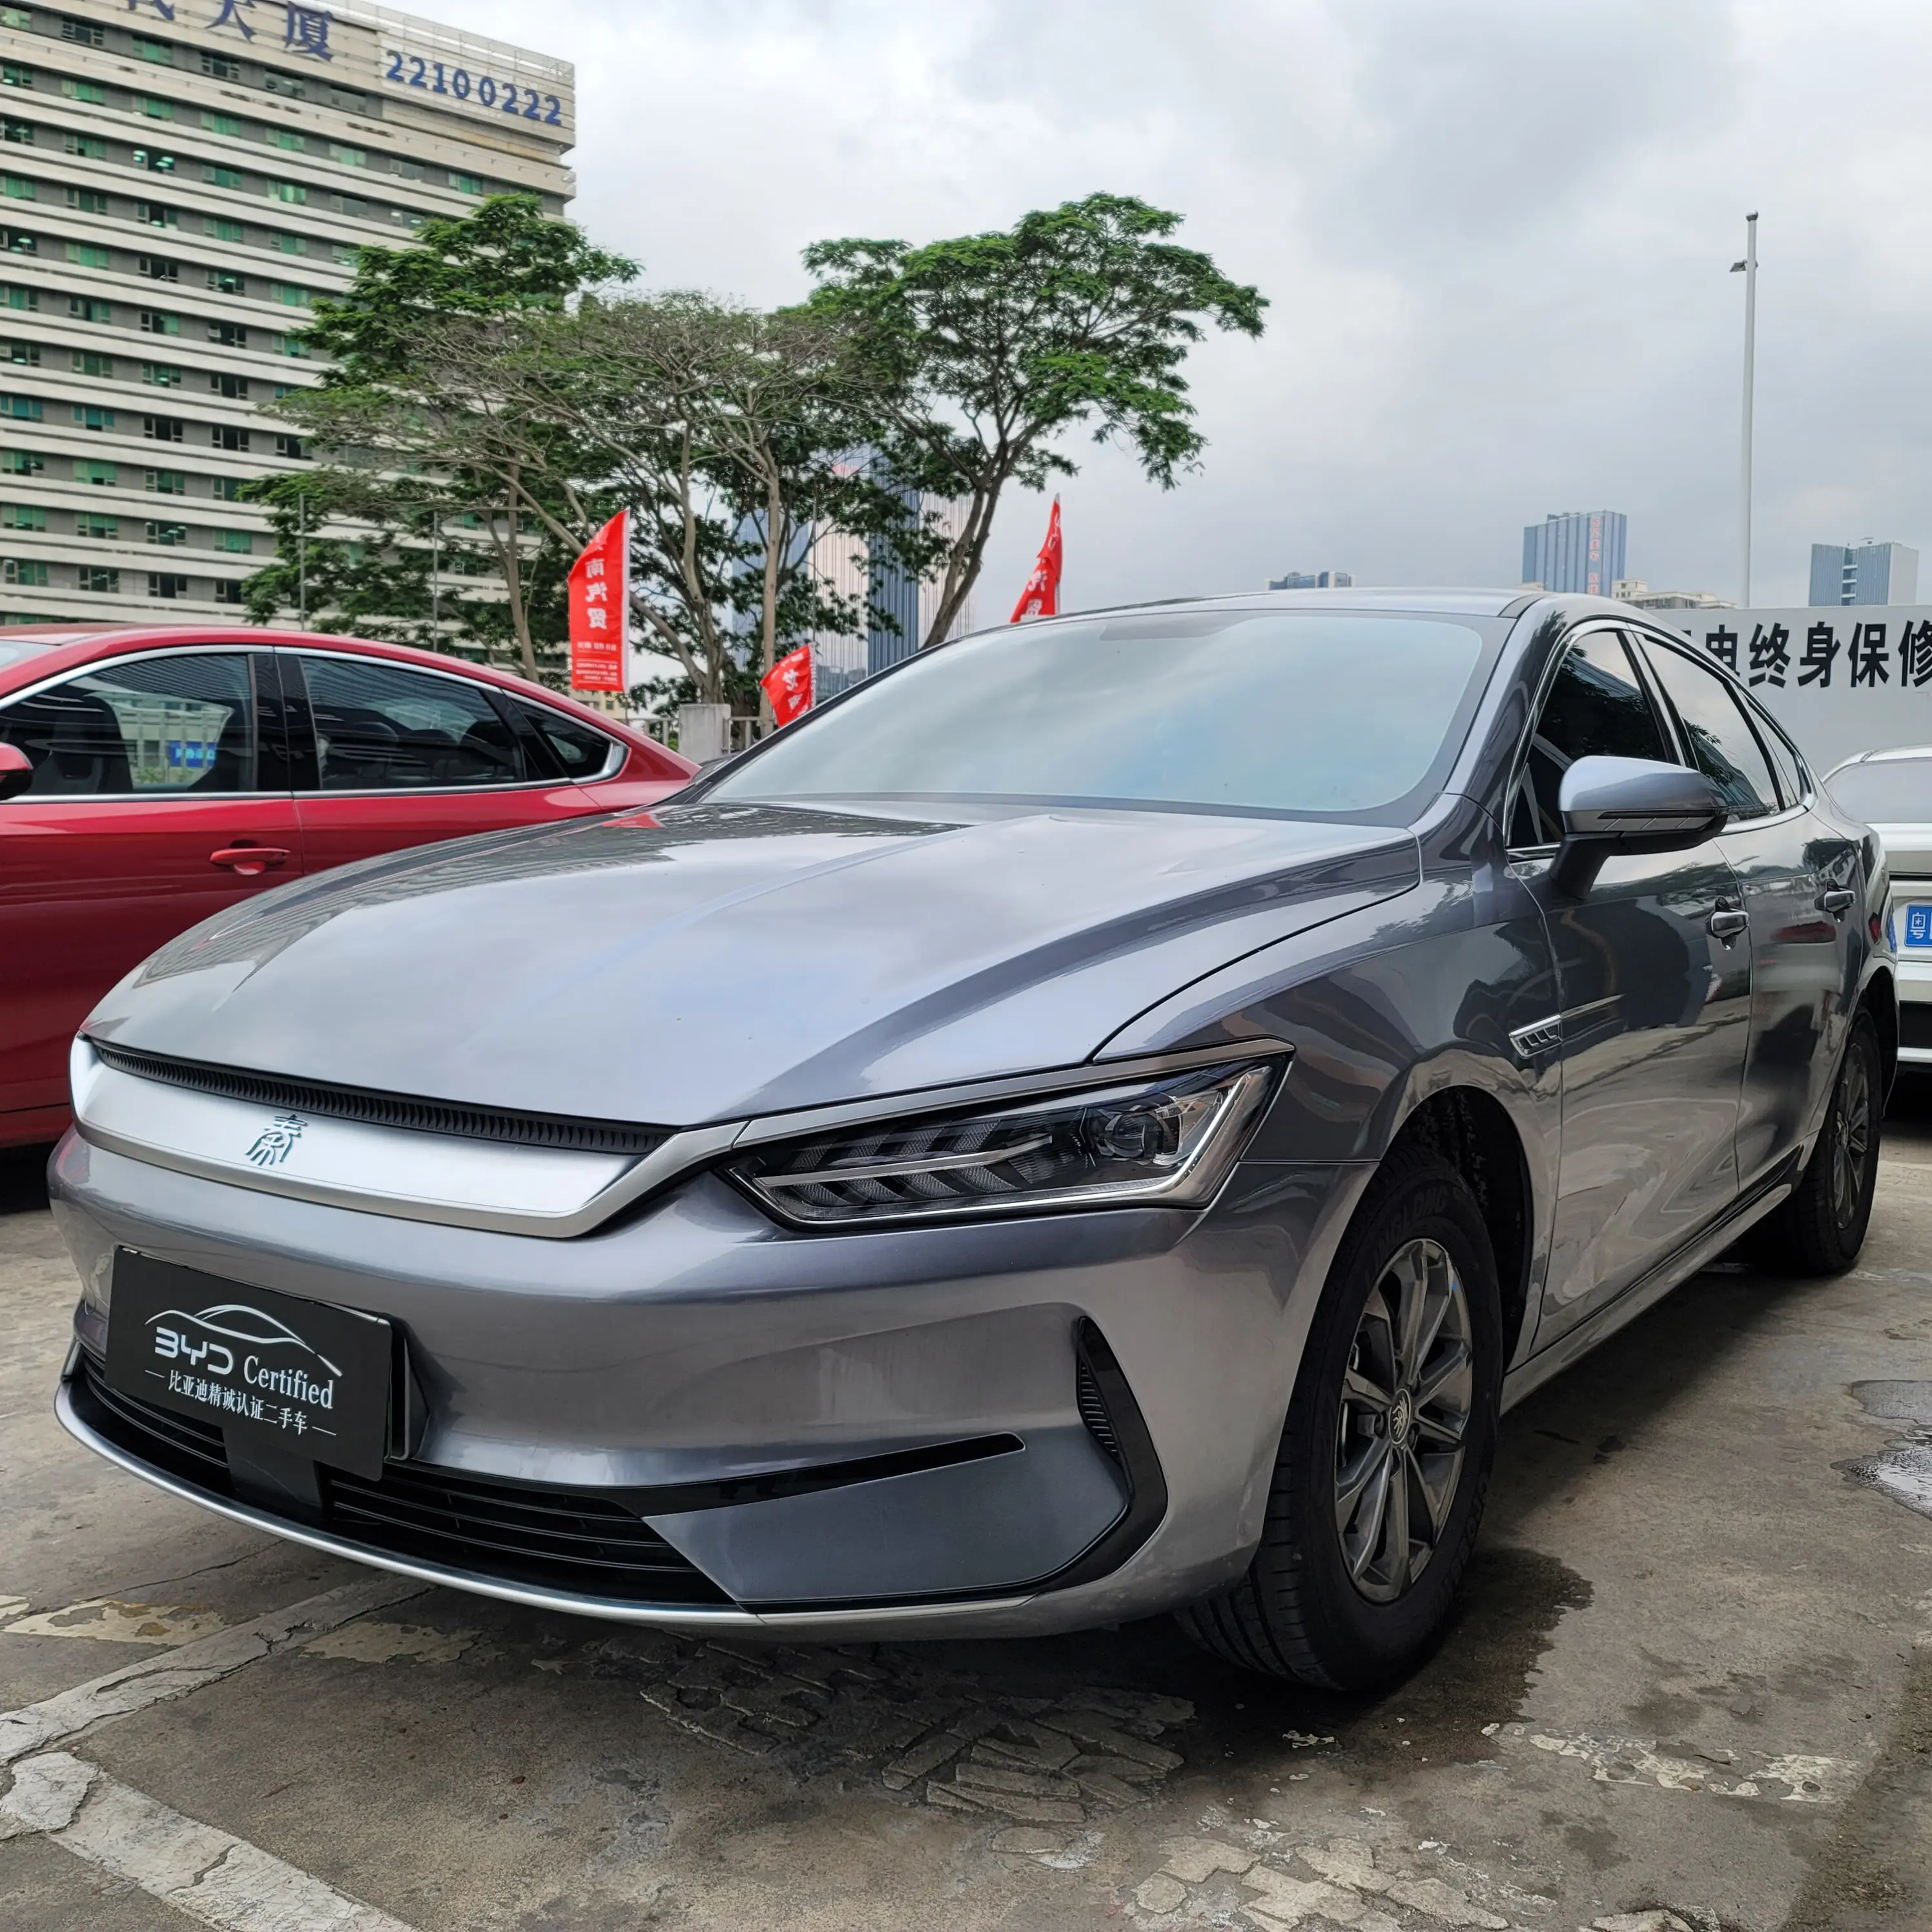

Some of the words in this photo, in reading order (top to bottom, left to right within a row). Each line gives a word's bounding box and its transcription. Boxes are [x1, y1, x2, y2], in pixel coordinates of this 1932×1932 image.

[127, 0, 333, 61] 大厦
[386, 49, 562, 126] 22100222
[1681, 620, 1932, 688] 电终身保修
[1909, 911, 1932, 940] 粤
[154, 1326, 234, 1375] BYD
[243, 1355, 334, 1409] Certified
[168, 1368, 308, 1436] 比亚迪精诚认证二手车
